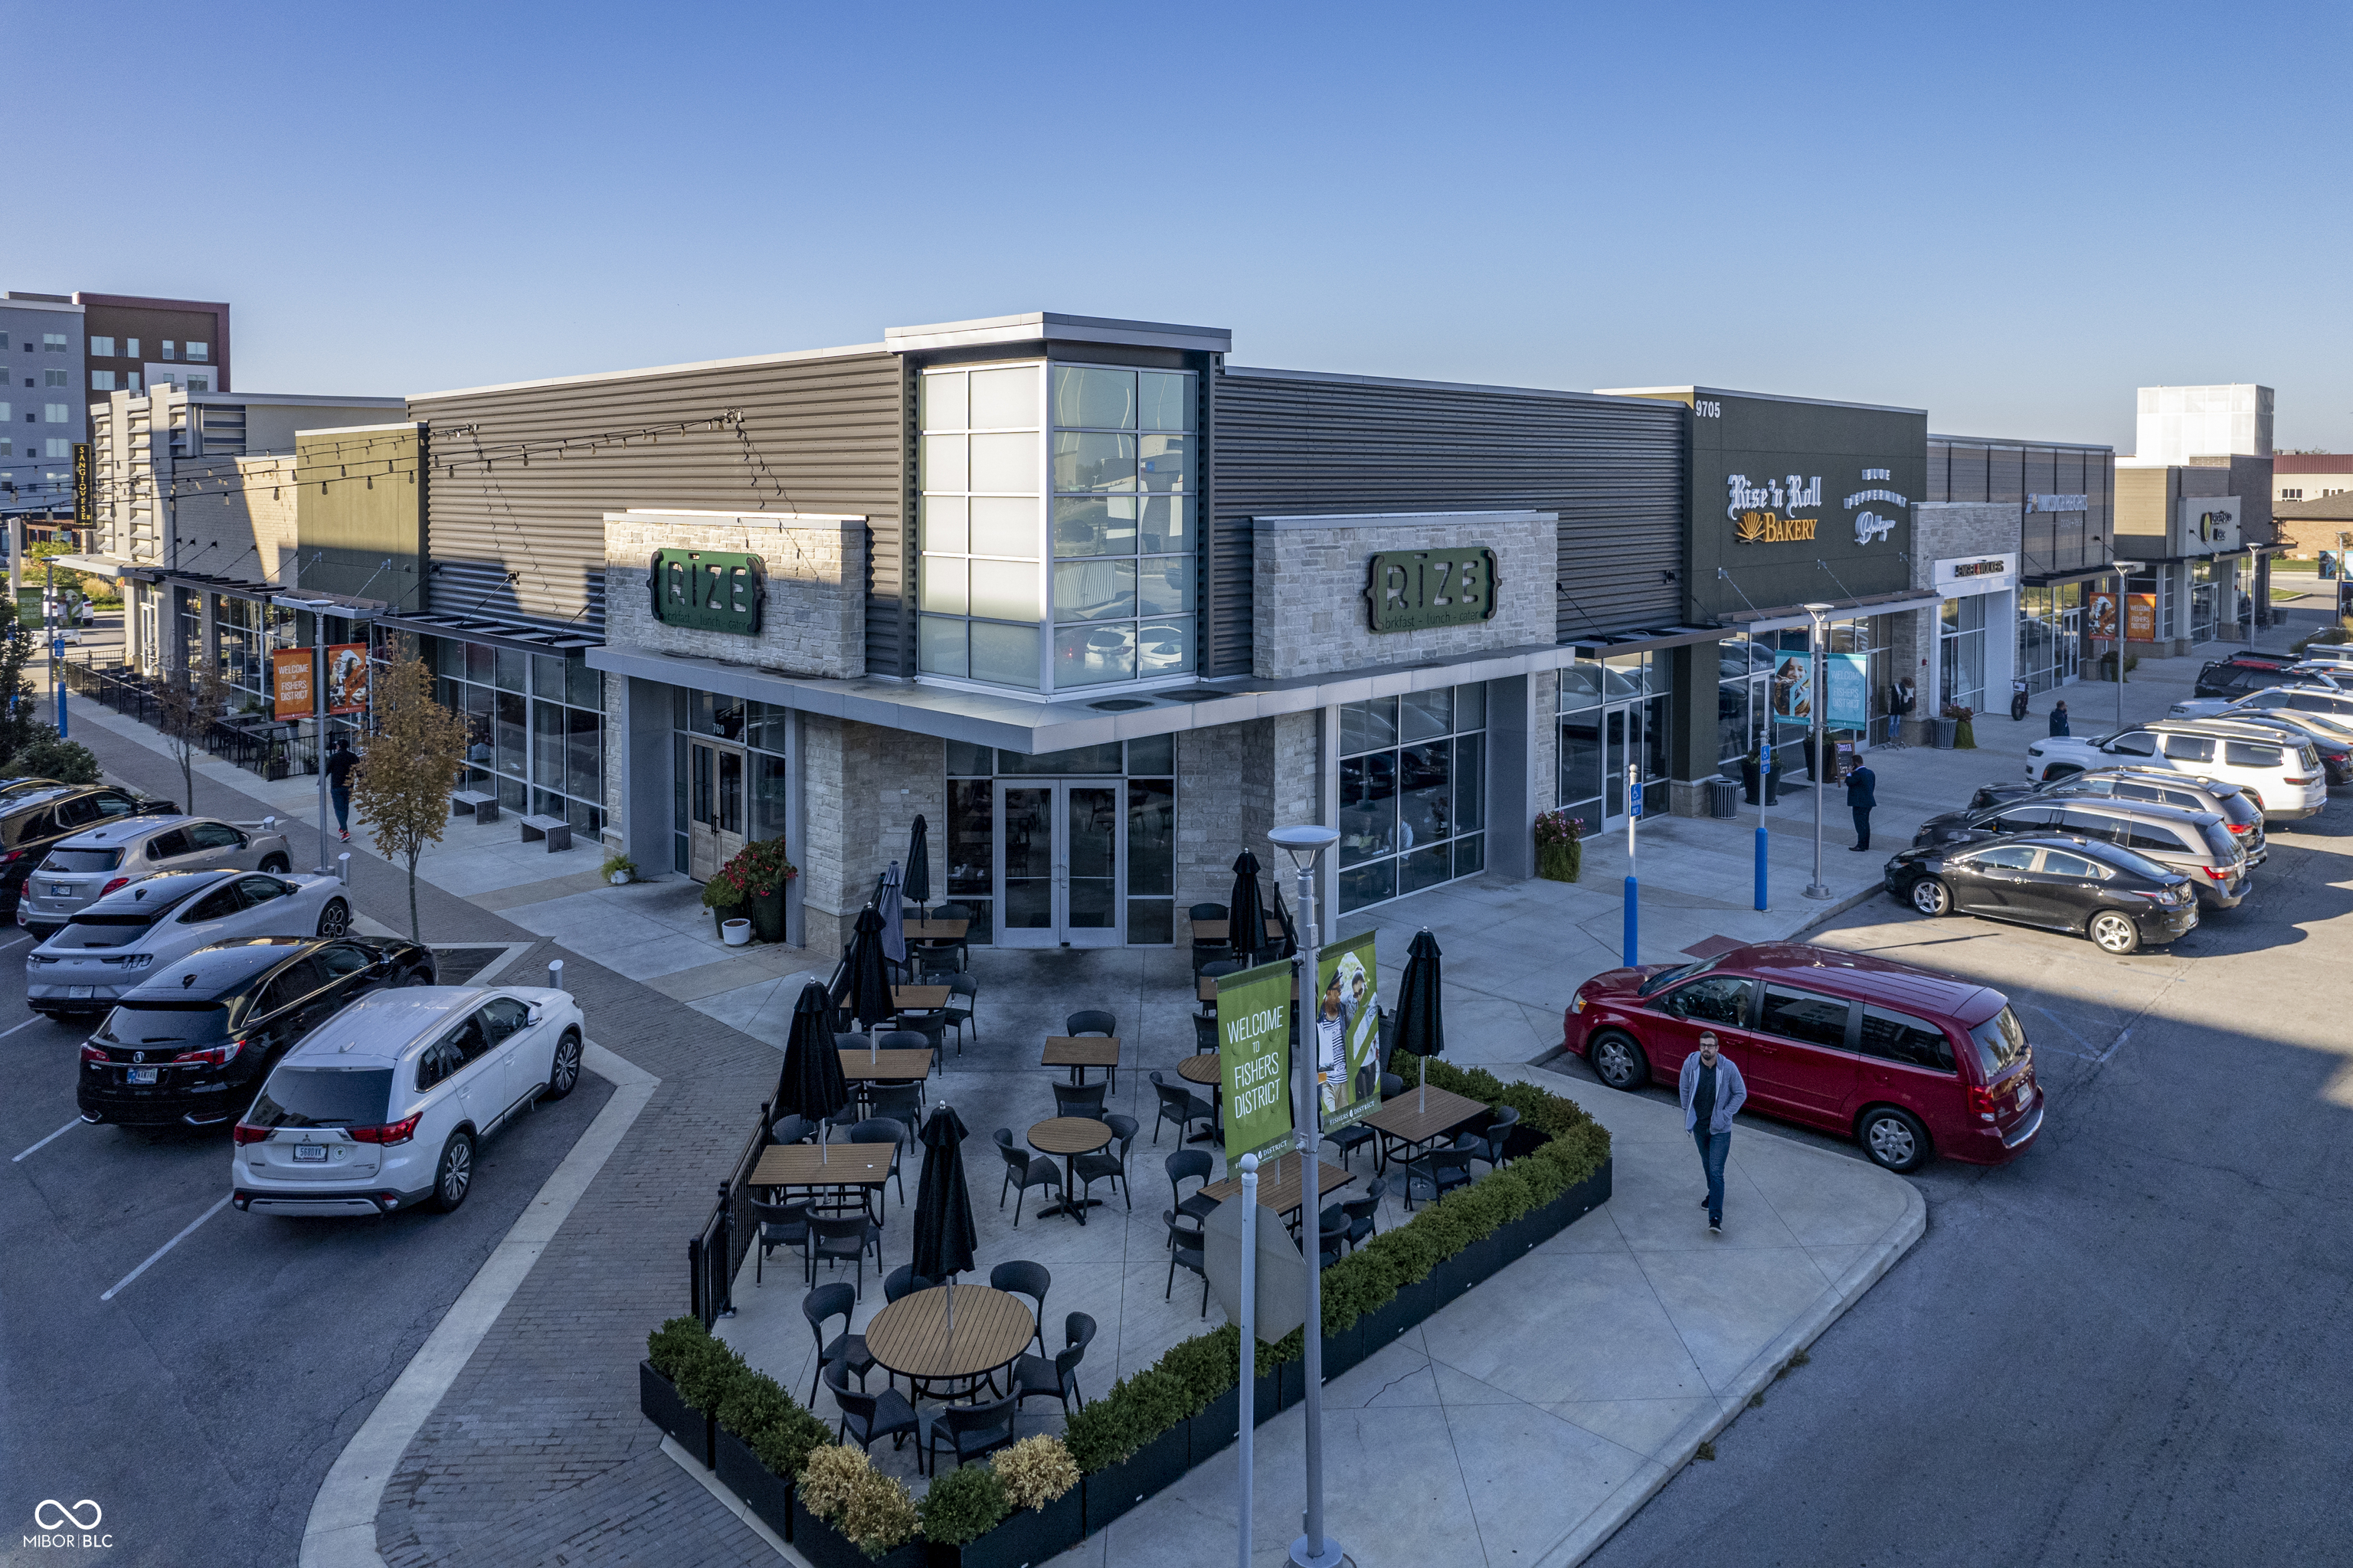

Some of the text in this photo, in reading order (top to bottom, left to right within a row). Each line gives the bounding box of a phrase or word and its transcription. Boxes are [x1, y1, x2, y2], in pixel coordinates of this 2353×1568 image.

[1696, 400, 1720, 418] 9705
[1861, 468, 1890, 481] BLUE
[1785, 475, 1822, 519] Roll
[1844, 489, 1906, 509] PEPPERMINT
[1763, 512, 1818, 542] BAKERY
[700, 614, 720, 627] lunch
[1385, 616, 1415, 630] brkfast
[1427, 614, 1451, 625] lunch
[1459, 611, 1478, 621] cater
[278, 663, 309, 674] WELCOME
[1831, 670, 1862, 682] WELCOME
[281, 680, 307, 691] FISHERS
[280, 689, 308, 702] DISTRICT
[1833, 688, 1859, 699] FISHERS
[1832, 698, 1860, 709] DISTRICT
[712, 722, 725, 735] 760
[1227, 1006, 1284, 1044] WELCOME
[1252, 1041, 1260, 1053] TO
[1234, 1052, 1279, 1089] FISHERS
[1235, 1079, 1281, 1119] DISTRICT
[1329, 1113, 1349, 1125] FISHERS
[1353, 1100, 1375, 1115] DISTRICT
[1263, 1140, 1288, 1156] DISTRICT
